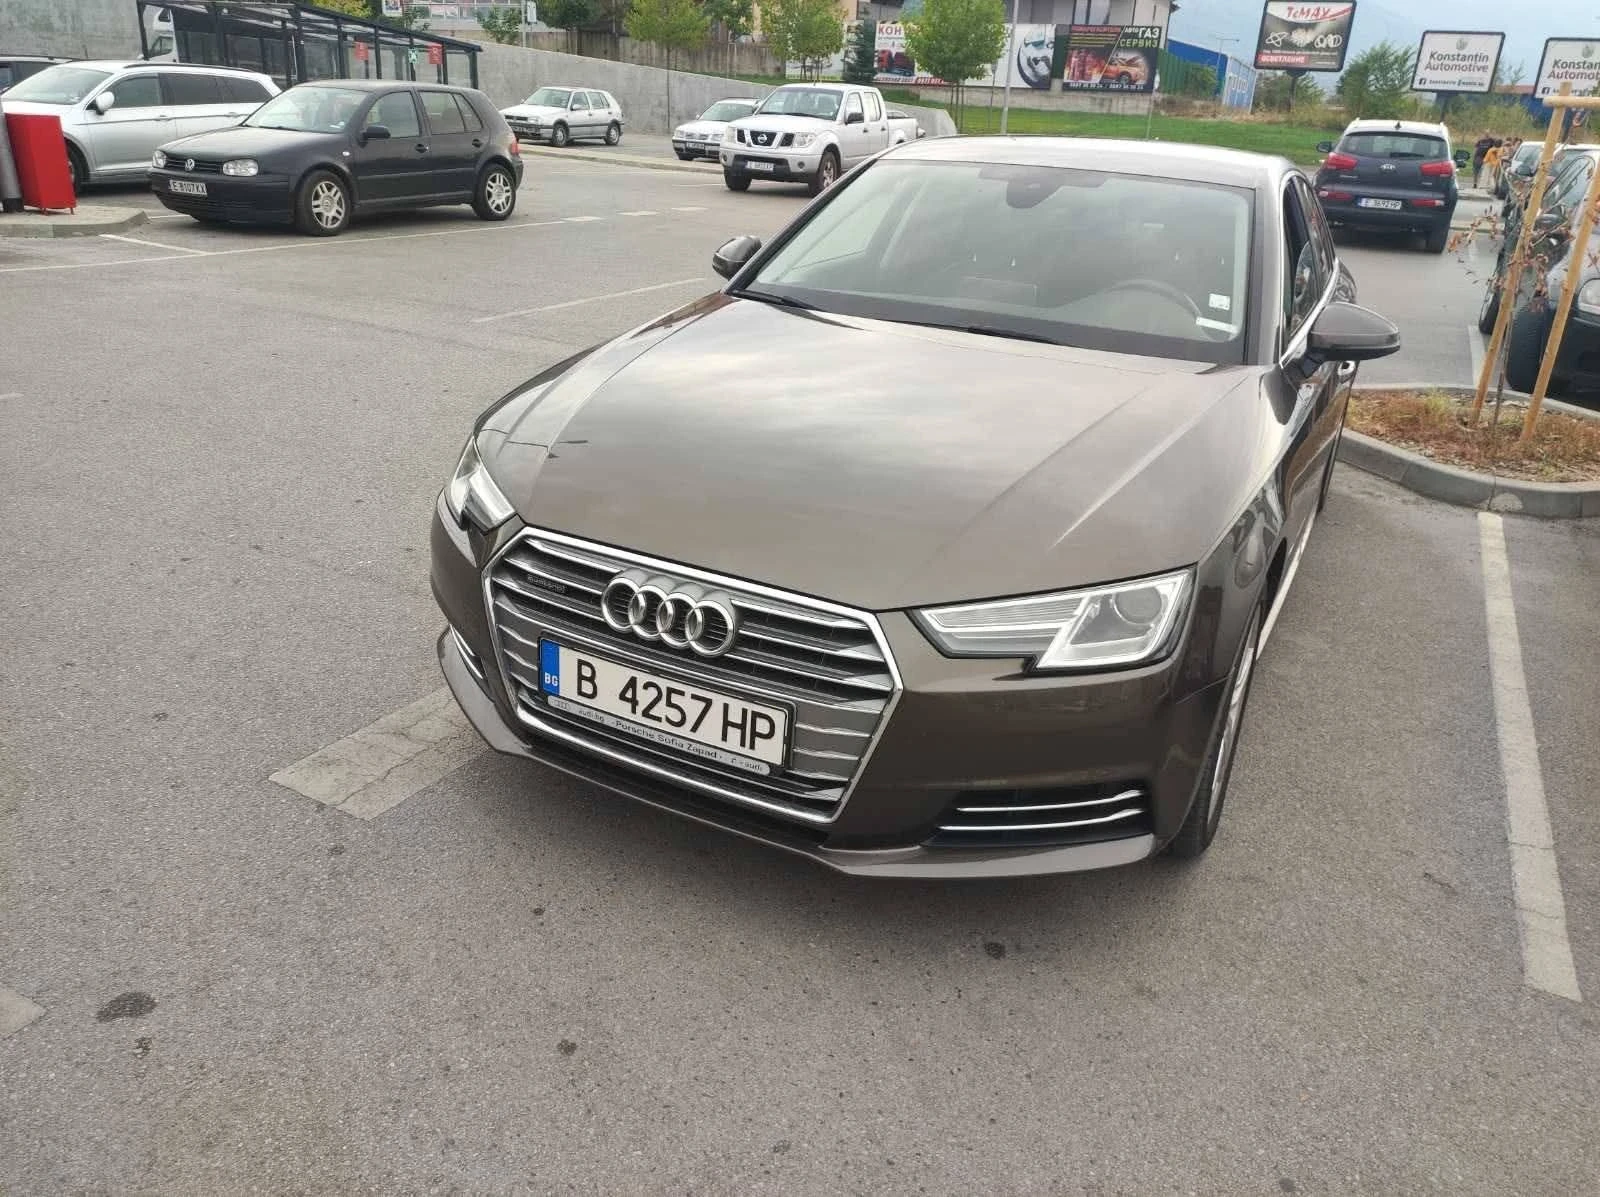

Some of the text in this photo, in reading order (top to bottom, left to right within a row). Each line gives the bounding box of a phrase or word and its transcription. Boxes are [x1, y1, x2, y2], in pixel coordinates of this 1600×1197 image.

[1138, 27, 1160, 39] ГАЗ
[1120, 38, 1158, 48] СЕРВИЗ
[1429, 51, 1489, 63] Konstantin
[1424, 62, 1489, 73] Automotive
[544, 671, 559, 687] BG
[576, 658, 776, 750] B 4257 HP
[657, 734, 684, 749] Sofia
